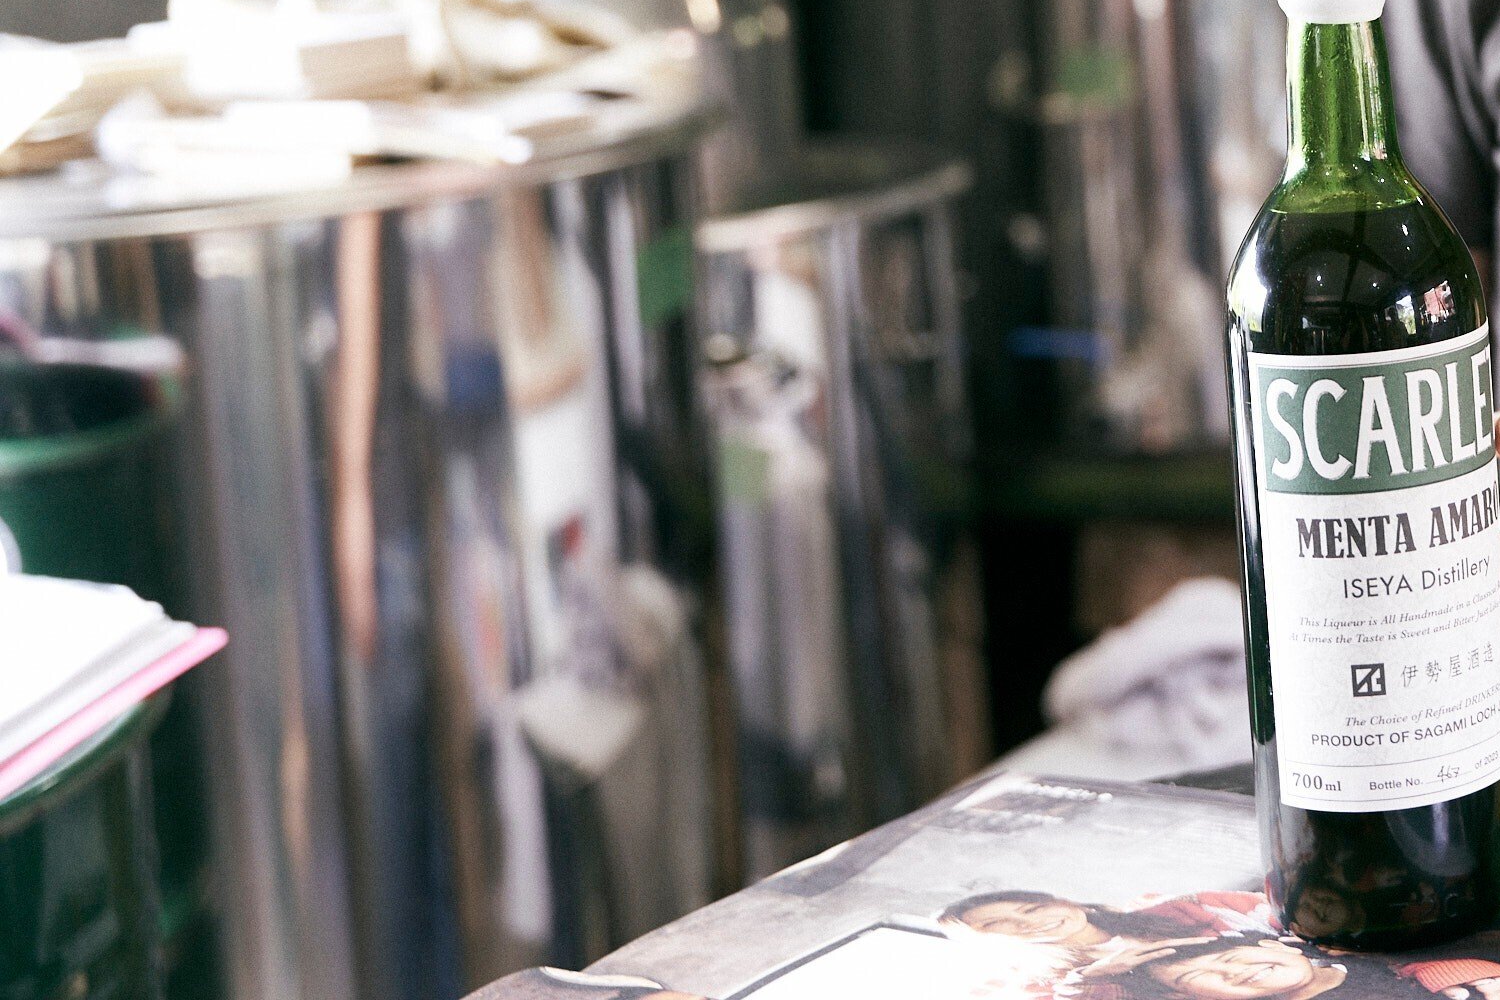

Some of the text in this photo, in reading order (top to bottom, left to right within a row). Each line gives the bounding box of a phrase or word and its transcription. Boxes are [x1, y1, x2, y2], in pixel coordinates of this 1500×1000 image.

[1296, 481, 1499, 558] MENTA AMARO
[1343, 574, 1412, 599] ISEYA
[1421, 555, 1490, 590] Distillery
[1300, 616, 1320, 627] This
[1323, 617, 1367, 629] Liqueur
[1368, 616, 1378, 626] is
[1380, 614, 1396, 625] All
[1399, 603, 1453, 623] Handmade
[1456, 603, 1464, 611] in
[1303, 633, 1333, 644] Times
[1335, 634, 1353, 644] the
[1355, 633, 1385, 643] Taste
[1388, 631, 1397, 640] is
[1400, 627, 1433, 640] Sweet
[1433, 621, 1451, 633] and
[1453, 613, 1476, 628] Bitter
[1401, 642, 1494, 688] 伊勢屋酒造
[1311, 733, 1385, 747] PRODUCT
[1389, 731, 1410, 744] OF
[1414, 717, 1467, 741] SAGAMI
[1470, 704, 1497, 726] LOCH
[1345, 716, 1367, 727] The
[1370, 713, 1408, 726] Choice
[1411, 709, 1423, 723] of
[1425, 700, 1462, 719] Refined
[1369, 779, 1402, 791] Bottle
[1405, 778, 1424, 787] No.
[1474, 760, 1483, 770] of
